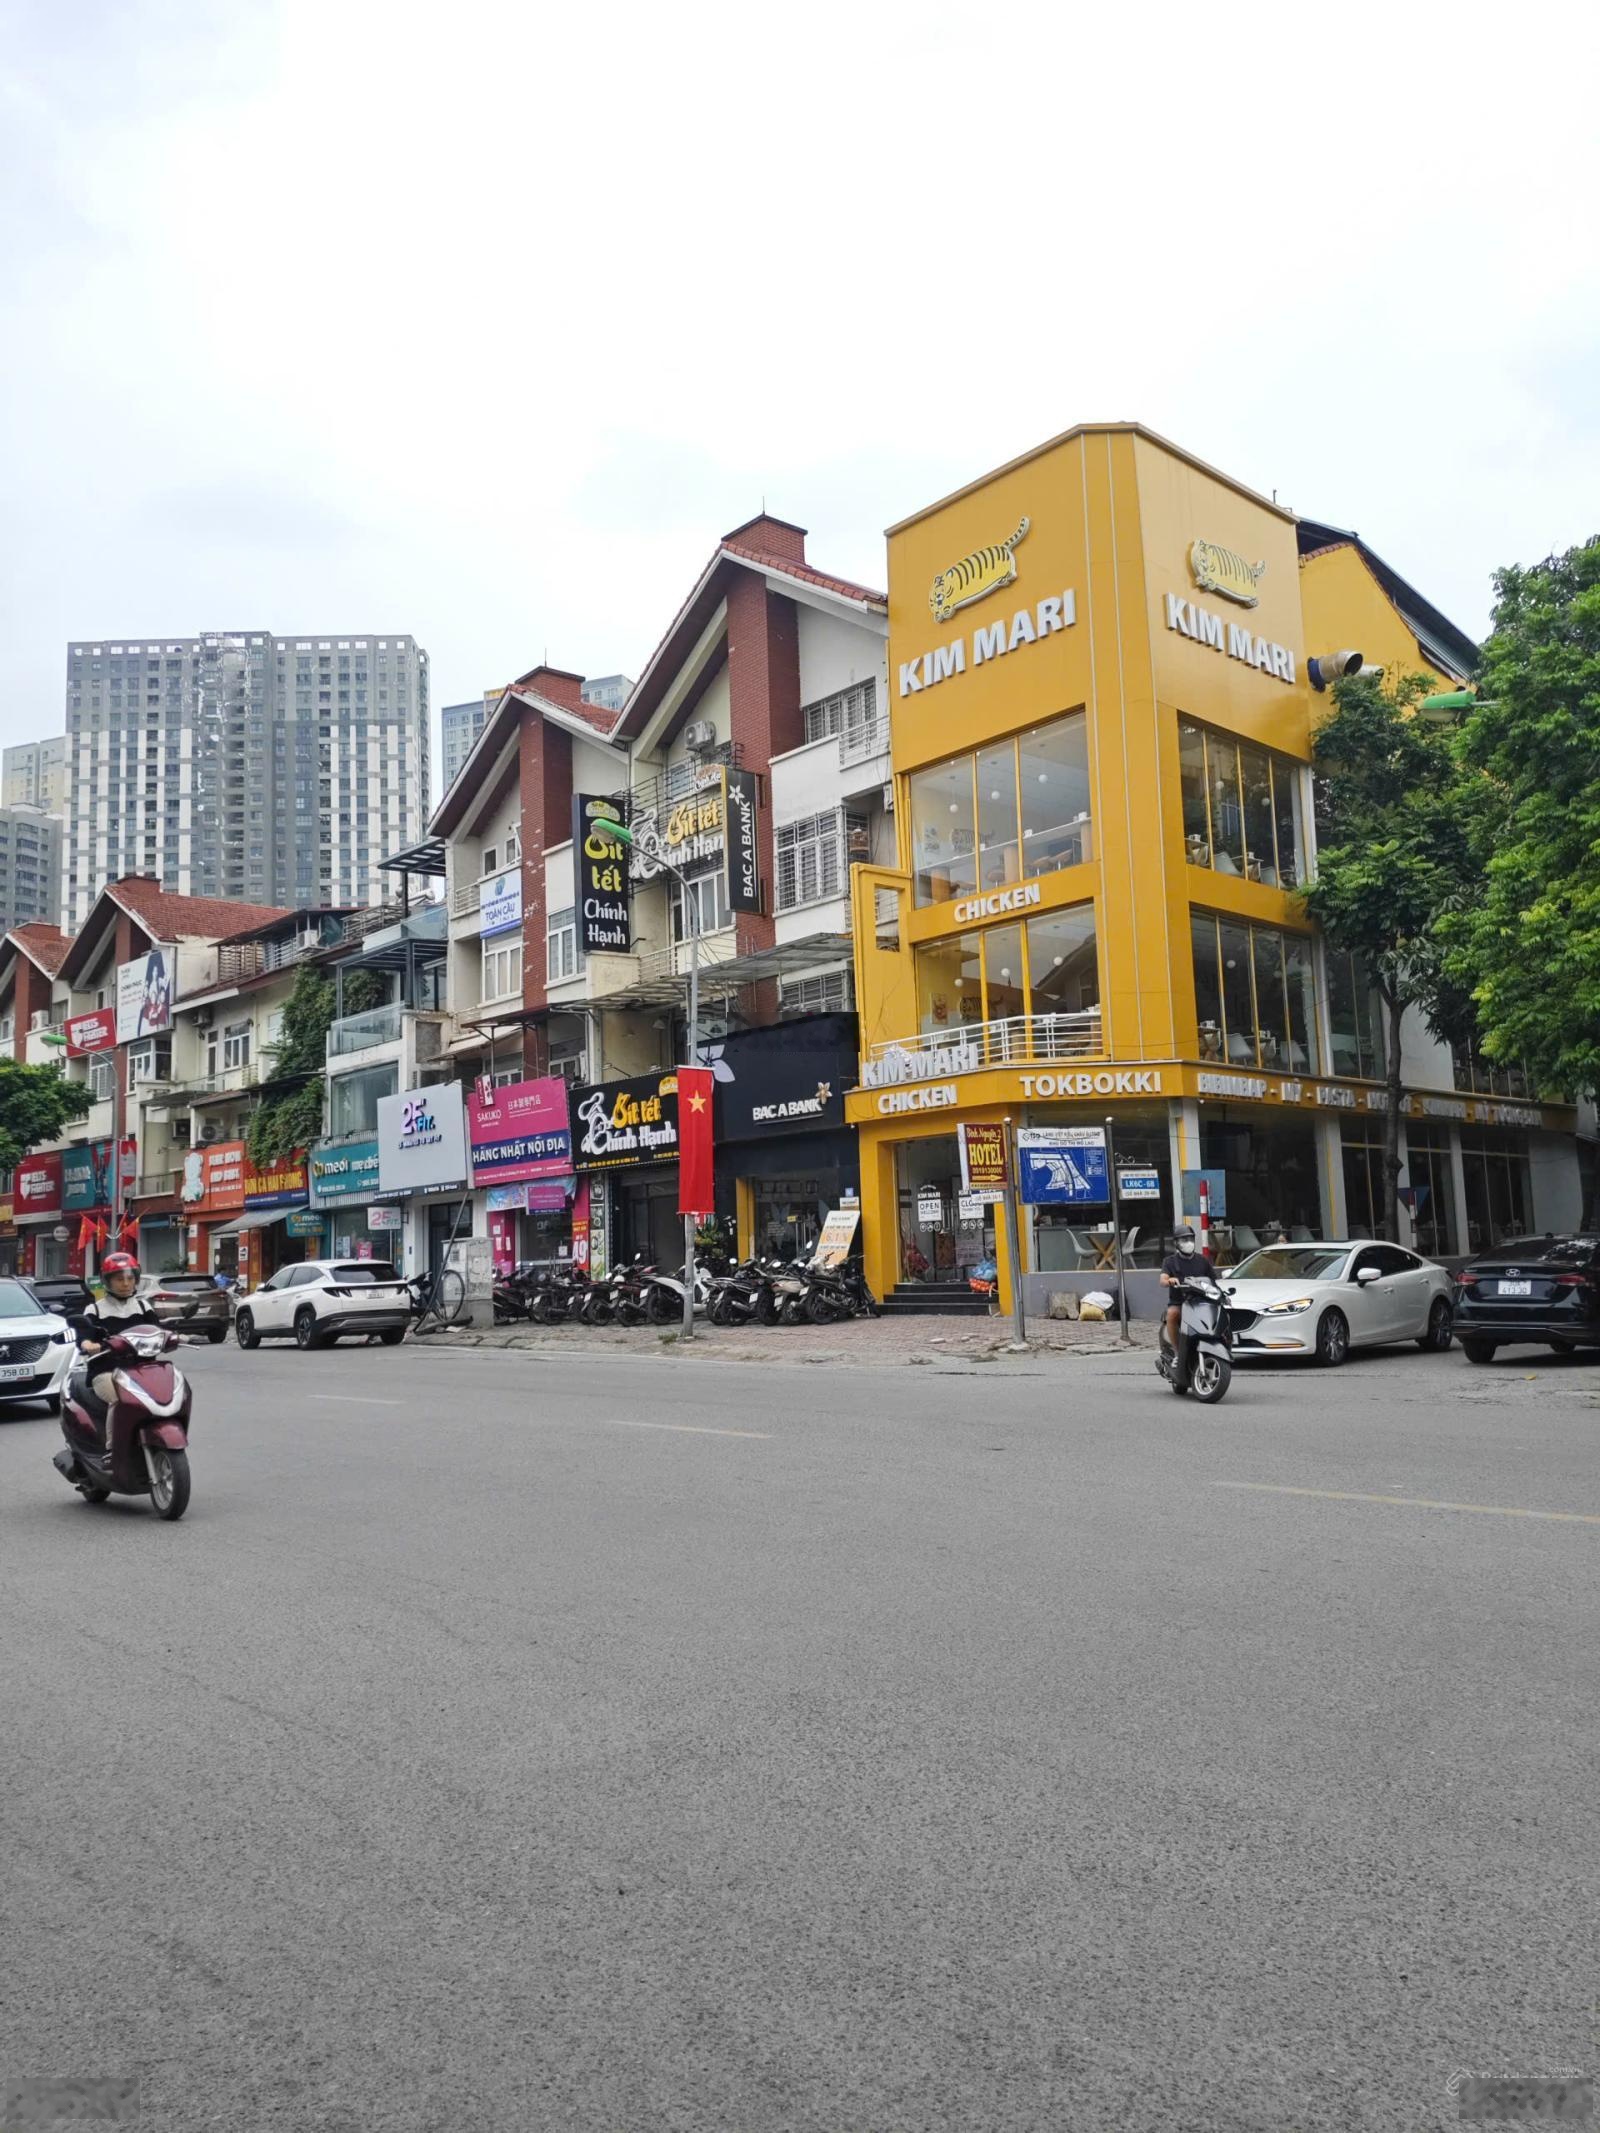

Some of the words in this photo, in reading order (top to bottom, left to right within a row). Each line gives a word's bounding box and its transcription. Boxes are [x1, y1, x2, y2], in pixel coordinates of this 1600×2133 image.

[899, 639, 966, 698] KIM
[974, 588, 1076, 666] MARI
[1163, 592, 1223, 652] KIM
[1225, 624, 1295, 684] MARI
[740, 799, 753, 846] BANK
[592, 865, 622, 892] tết
[584, 898, 628, 921] Chính
[954, 883, 1040, 923] CHICKEN
[587, 923, 626, 946] Hạnh
[863, 1053, 906, 1088] KIM
[911, 1043, 978, 1080] MARI
[1019, 1071, 1162, 1098] TOKBOKKI
[1316, 1086, 1357, 1107] PASTA
[752, 1105, 777, 1121] BAC
[777, 1103, 789, 1118] A
[788, 1098, 822, 1116] BANK
[879, 1085, 957, 1115] CHICKEN
[477, 1109, 502, 1122] SAKUKO
[968, 1143, 1003, 1166] HOTEL
[919, 1202, 940, 1210] OPEN
